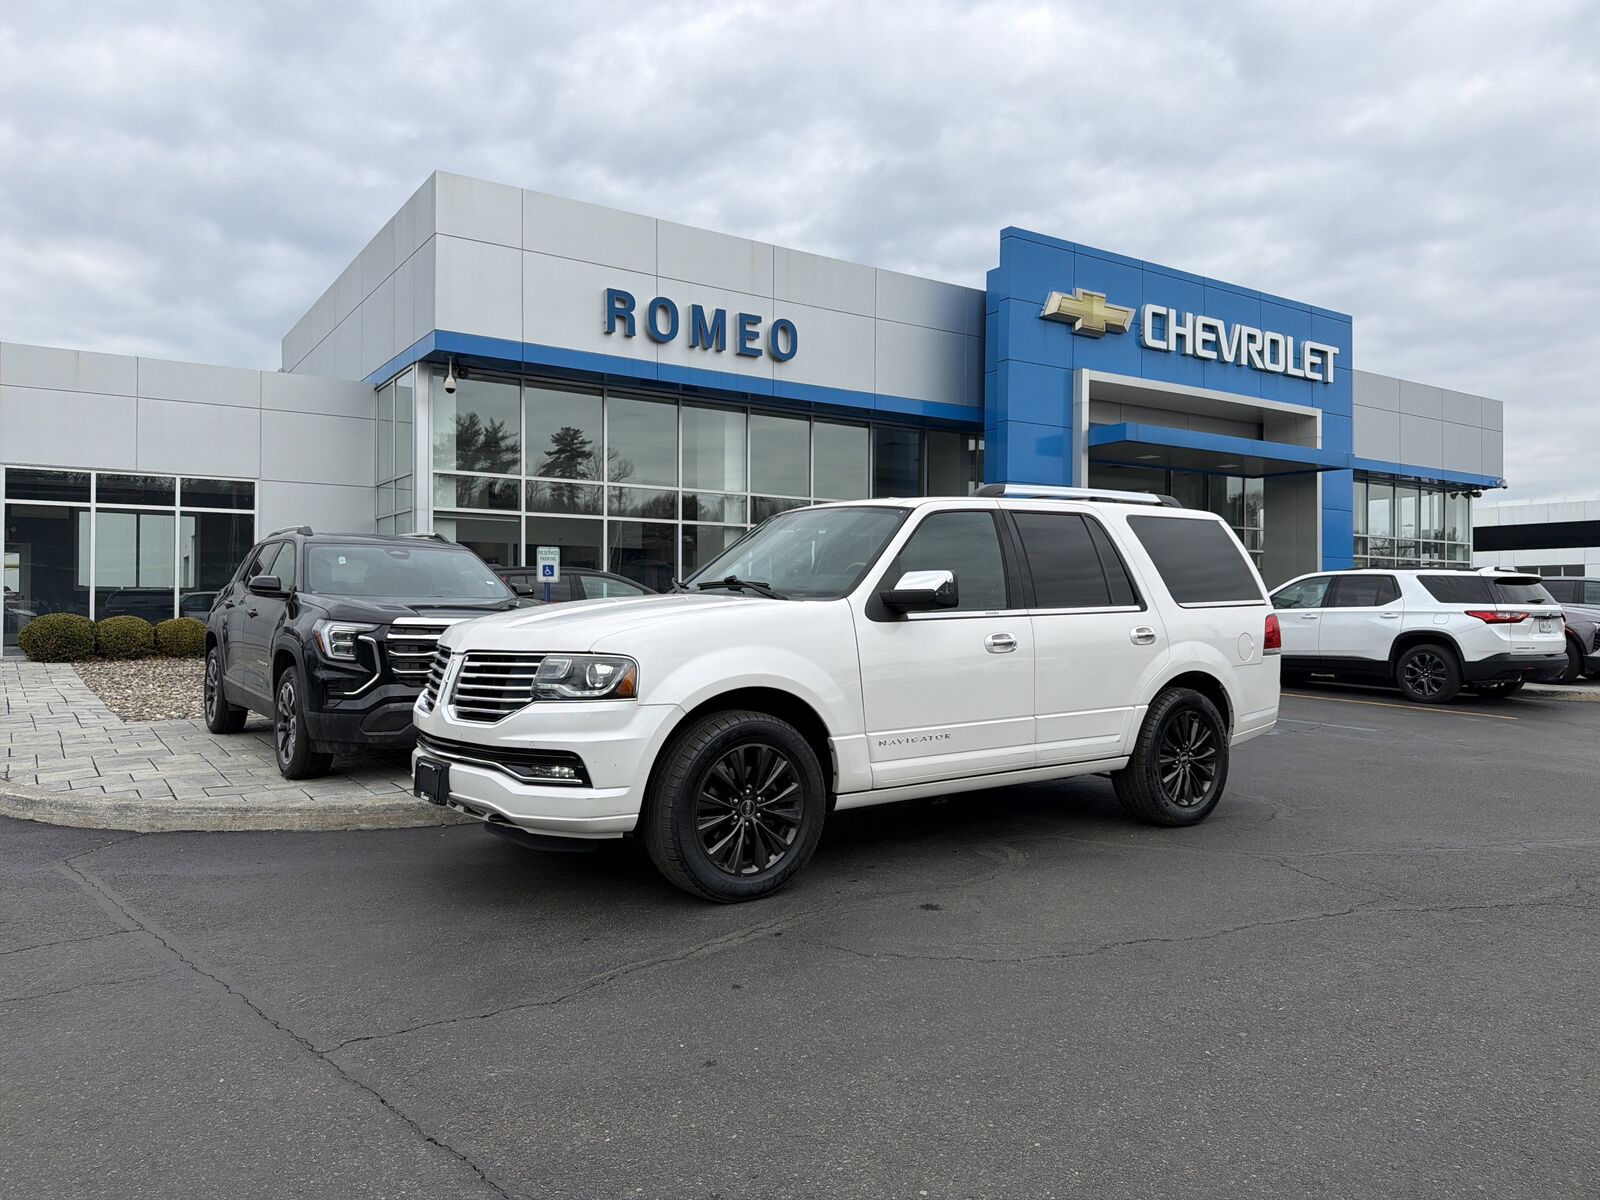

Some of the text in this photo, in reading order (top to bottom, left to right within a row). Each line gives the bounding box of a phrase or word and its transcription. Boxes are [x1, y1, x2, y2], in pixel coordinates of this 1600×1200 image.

[604, 287, 798, 362] ROMEO
[1141, 303, 1339, 384] CHEVROLET
[878, 733, 952, 747] NAVIGATOR
